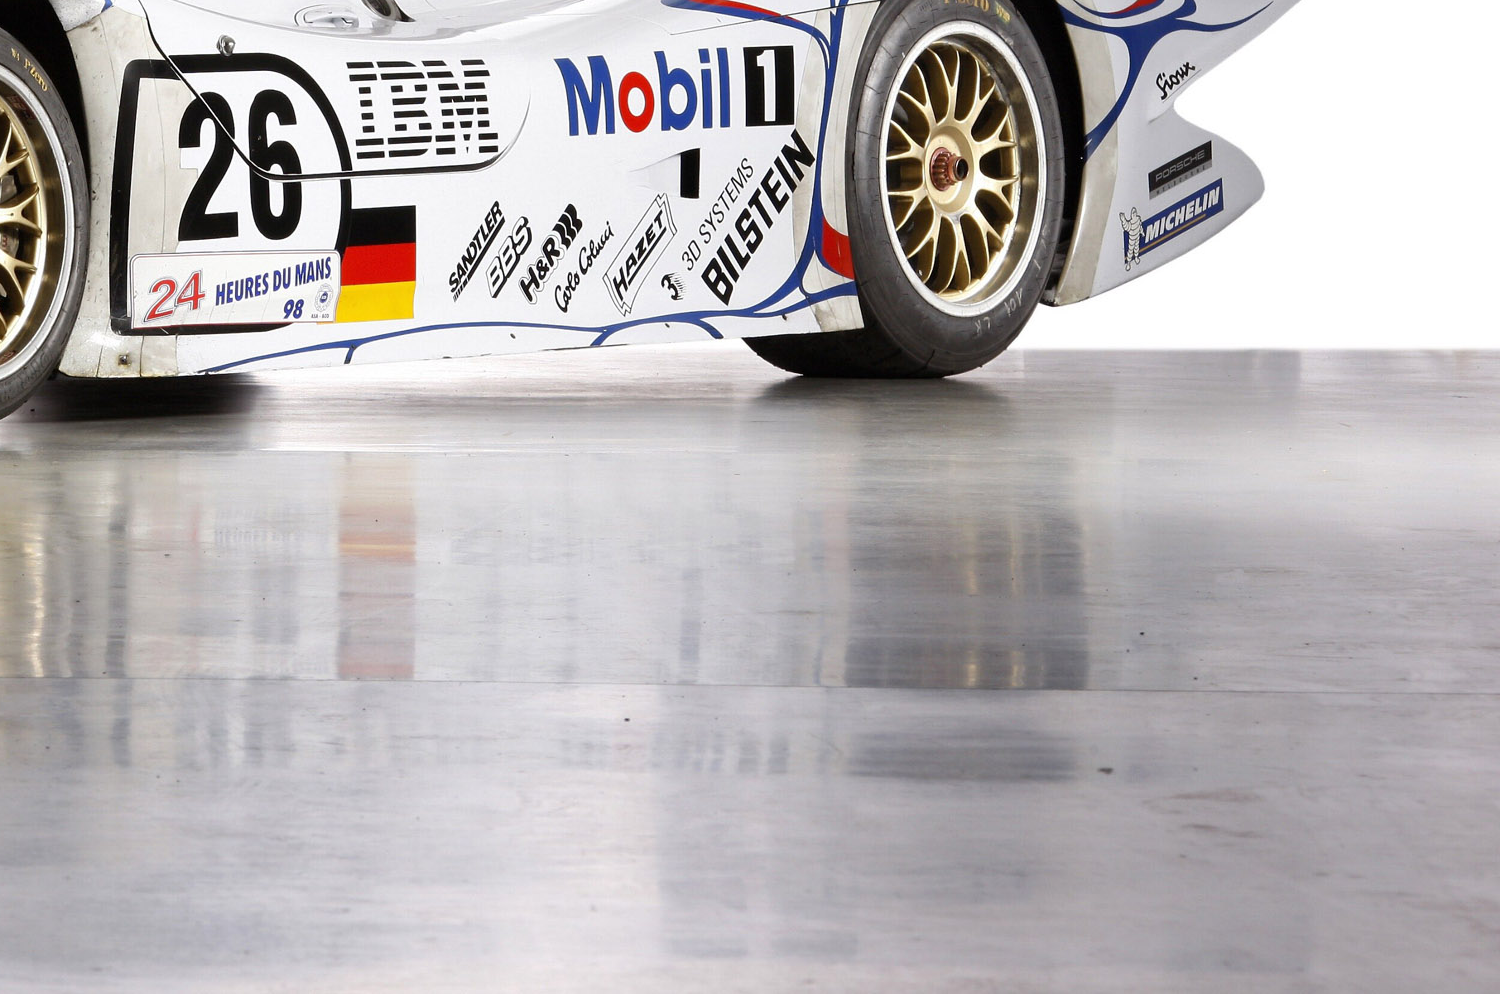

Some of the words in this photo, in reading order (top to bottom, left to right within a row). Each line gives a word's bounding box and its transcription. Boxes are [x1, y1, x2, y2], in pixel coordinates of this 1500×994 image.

[346, 59, 499, 160] IBM
[554, 46, 731, 137] Mobil
[1156, 61, 1196, 101] Sioux
[178, 88, 302, 242] 26
[1155, 149, 1205, 183] PORSCHE
[449, 200, 503, 294] SANDTLER
[486, 216, 533, 299] BBS
[612, 209, 665, 301] HAZET
[681, 239, 702, 272] 3D
[699, 157, 755, 245] SYSTEMS
[701, 128, 816, 306] BILSTEIN
[1144, 186, 1220, 244] MICHELIN
[144, 270, 206, 323] 24
[215, 272, 269, 306] HEURES
[272, 266, 292, 292] DU
[294, 256, 332, 287] MANS
[283, 298, 305, 319] 98
[518, 235, 566, 304] H&R
[555, 271, 580, 313] Carlo
[578, 220, 614, 276] Colucci
